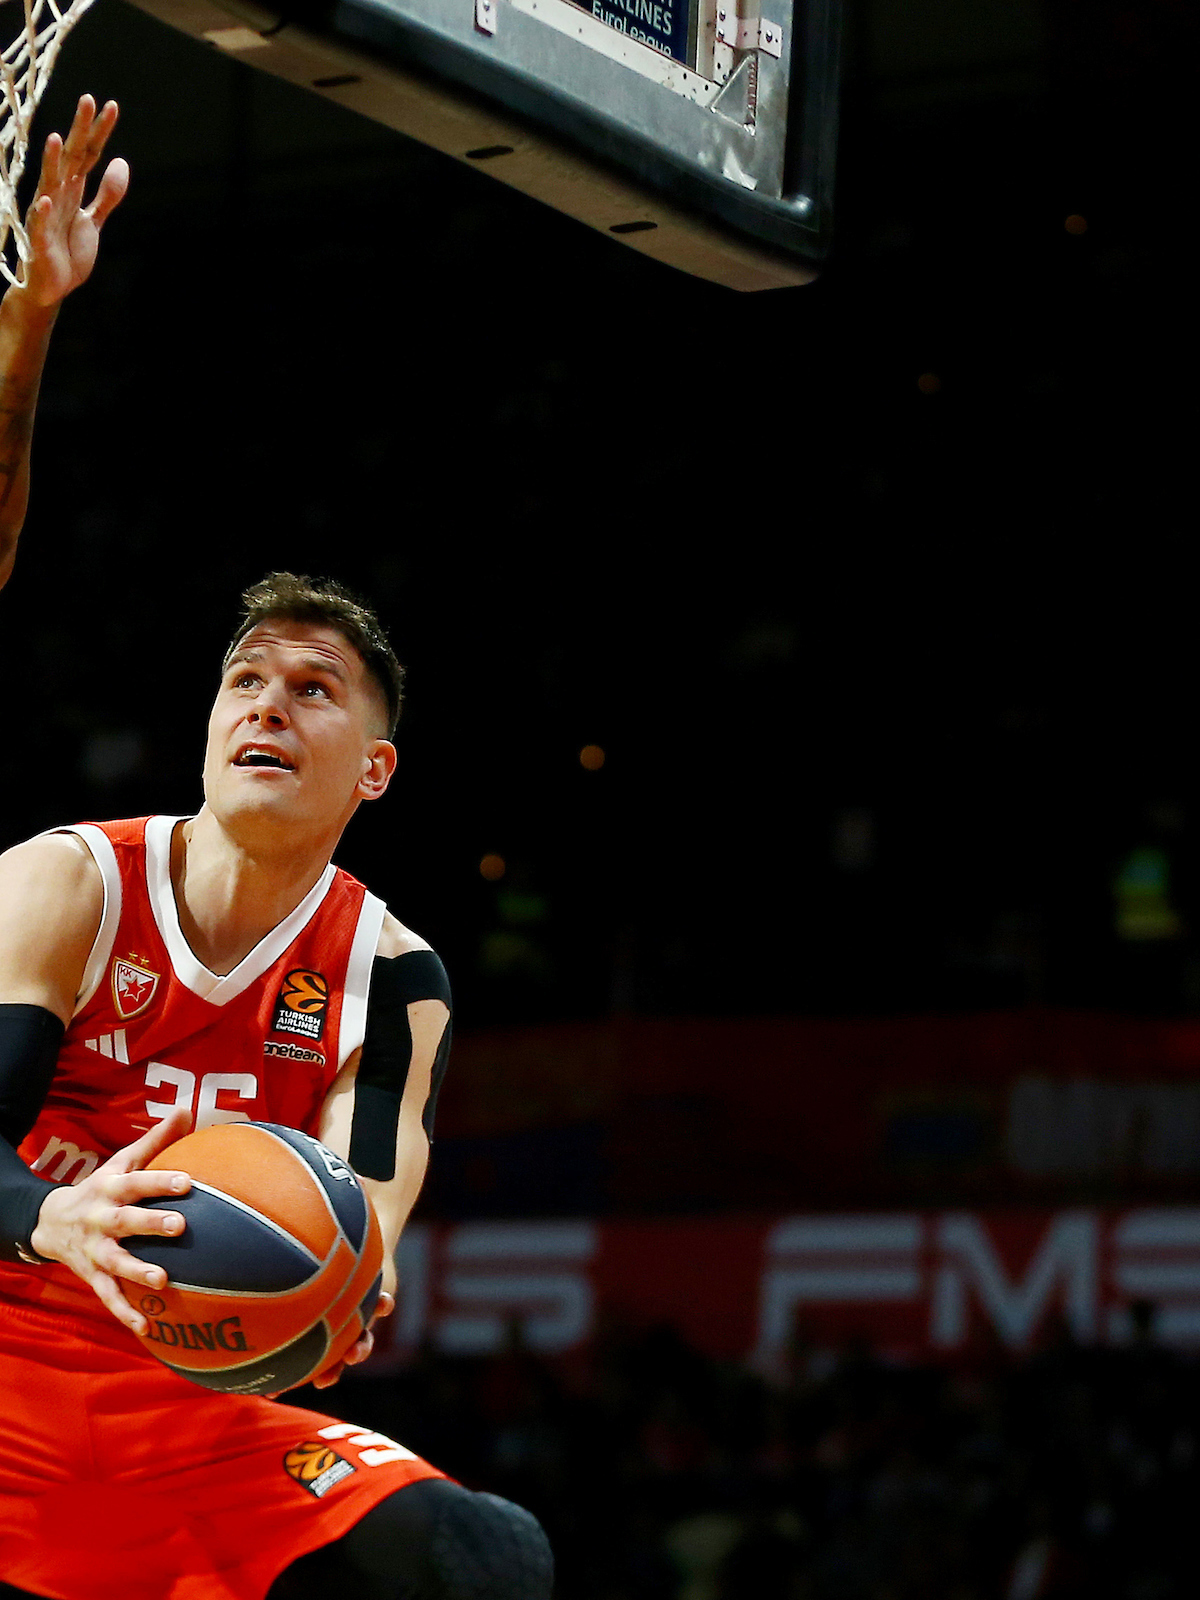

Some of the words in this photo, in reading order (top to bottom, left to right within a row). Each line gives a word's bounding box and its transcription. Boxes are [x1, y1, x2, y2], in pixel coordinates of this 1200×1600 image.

[277, 1017, 320, 1033] AIRLINES
[279, 1009, 321, 1026] TURKISH
[147, 1316, 248, 1352] LDING
